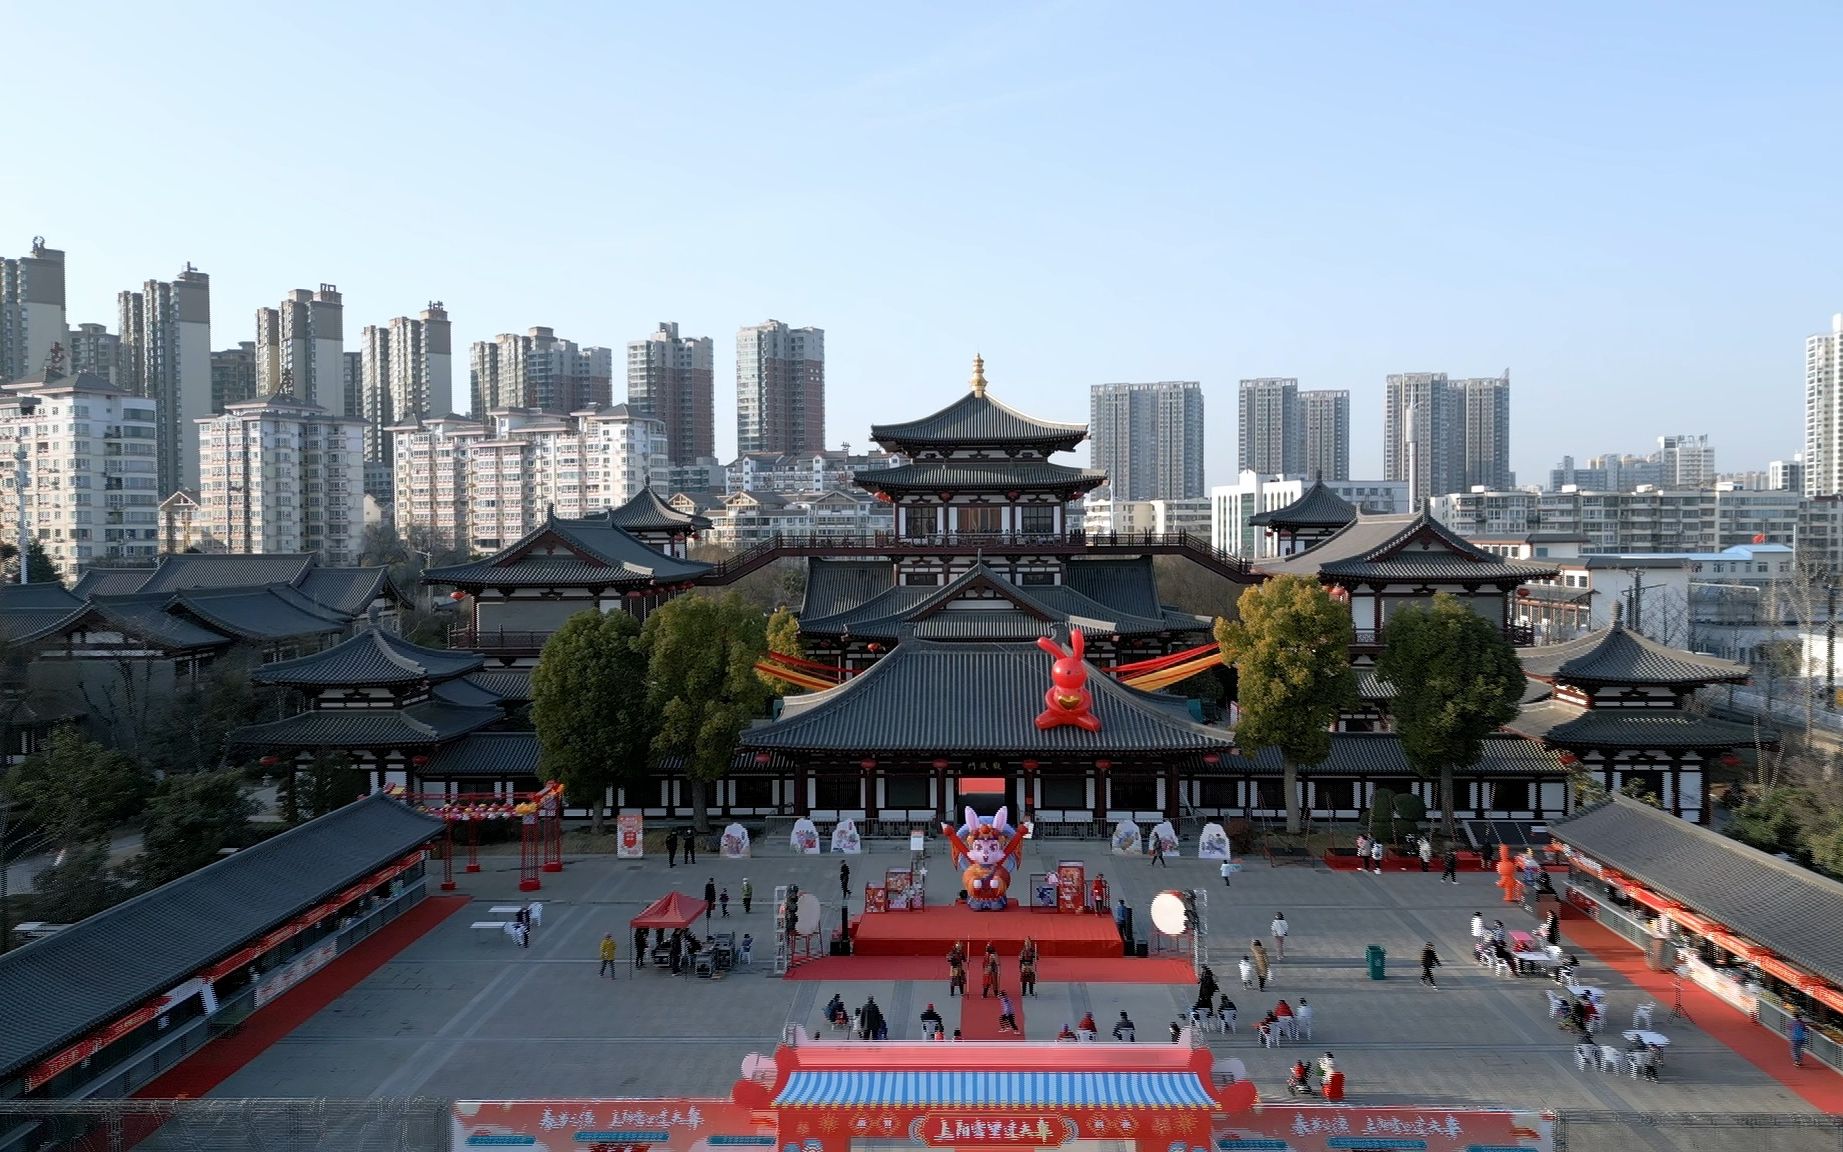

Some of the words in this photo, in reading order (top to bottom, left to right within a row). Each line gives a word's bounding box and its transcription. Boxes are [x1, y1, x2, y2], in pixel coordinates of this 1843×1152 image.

[934, 1117, 1054, 1144] 上阳宫里过大年
